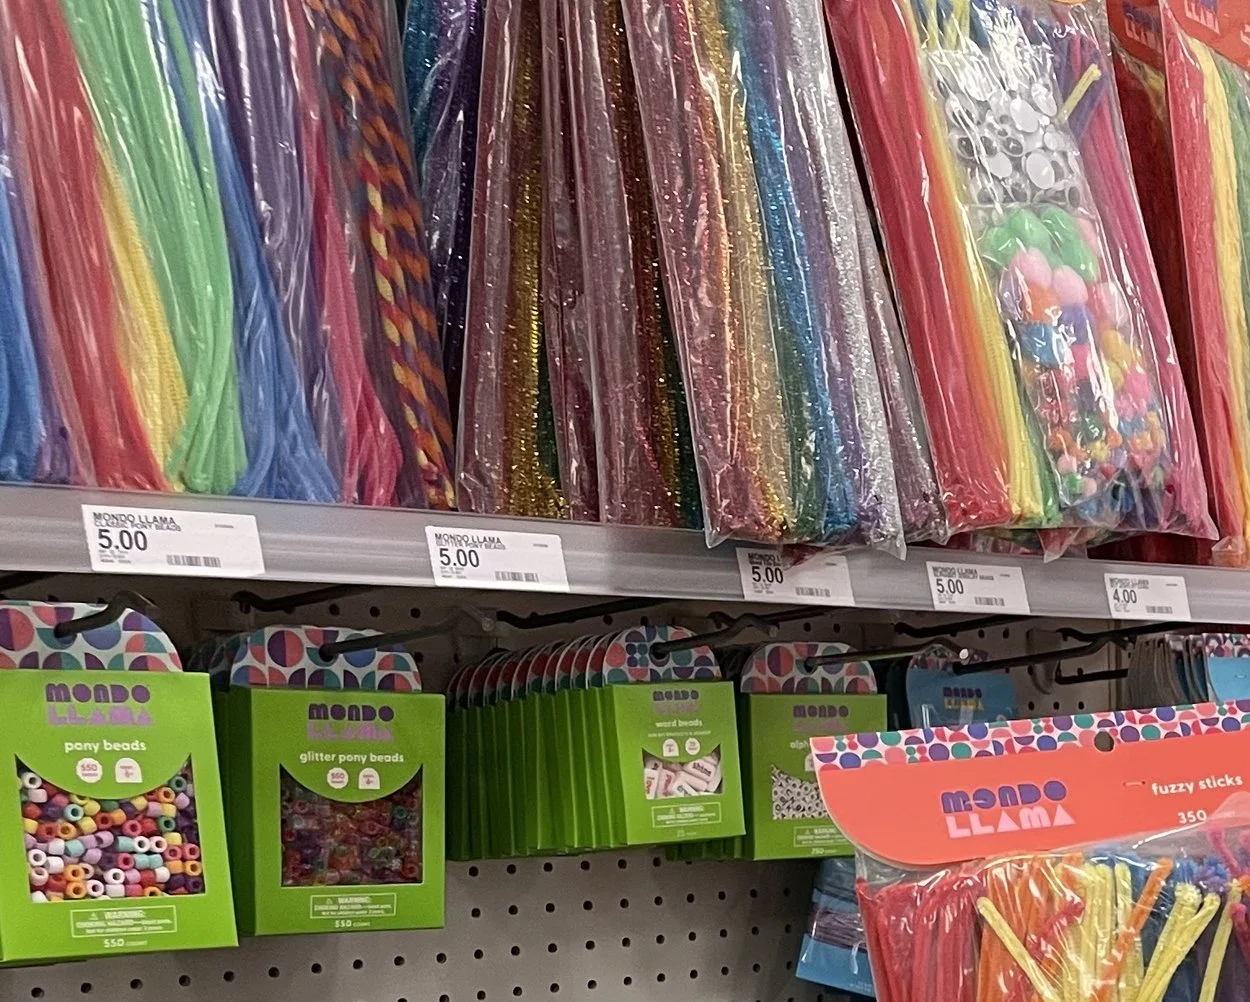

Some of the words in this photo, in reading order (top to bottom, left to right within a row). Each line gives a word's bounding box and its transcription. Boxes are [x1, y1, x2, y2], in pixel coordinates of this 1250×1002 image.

[93, 512, 135, 523] MONDO
[138, 515, 177, 525] LLAMA
[98, 529, 148, 551] 5.00
[435, 533, 469, 543] MONDO
[471, 535, 502, 545] LLAMA
[440, 548, 480, 568] 5.00
[751, 565, 784, 584] 5.00
[936, 578, 964, 594] 5.00
[1112, 589, 1137, 604] 4.00
[45, 683, 151, 704] MONDO
[48, 704, 153, 726] LLAMA
[308, 703, 395, 722] MONDO
[793, 704, 849, 718] MONDO
[64, 740, 100, 753] pony
[103, 740, 147, 751] beads
[300, 752, 337, 764] glitter
[338, 753, 367, 765] pony
[370, 752, 404, 763] beads
[1152, 781, 1195, 796] fuzzy
[1198, 774, 1243, 789] sticks
[941, 779, 1068, 814] MONDO
[947, 803, 1076, 839] LLAMA
[1177, 809, 1208, 825] 350
[335, 920, 352, 928] 550
[103, 938, 125, 948] 550
